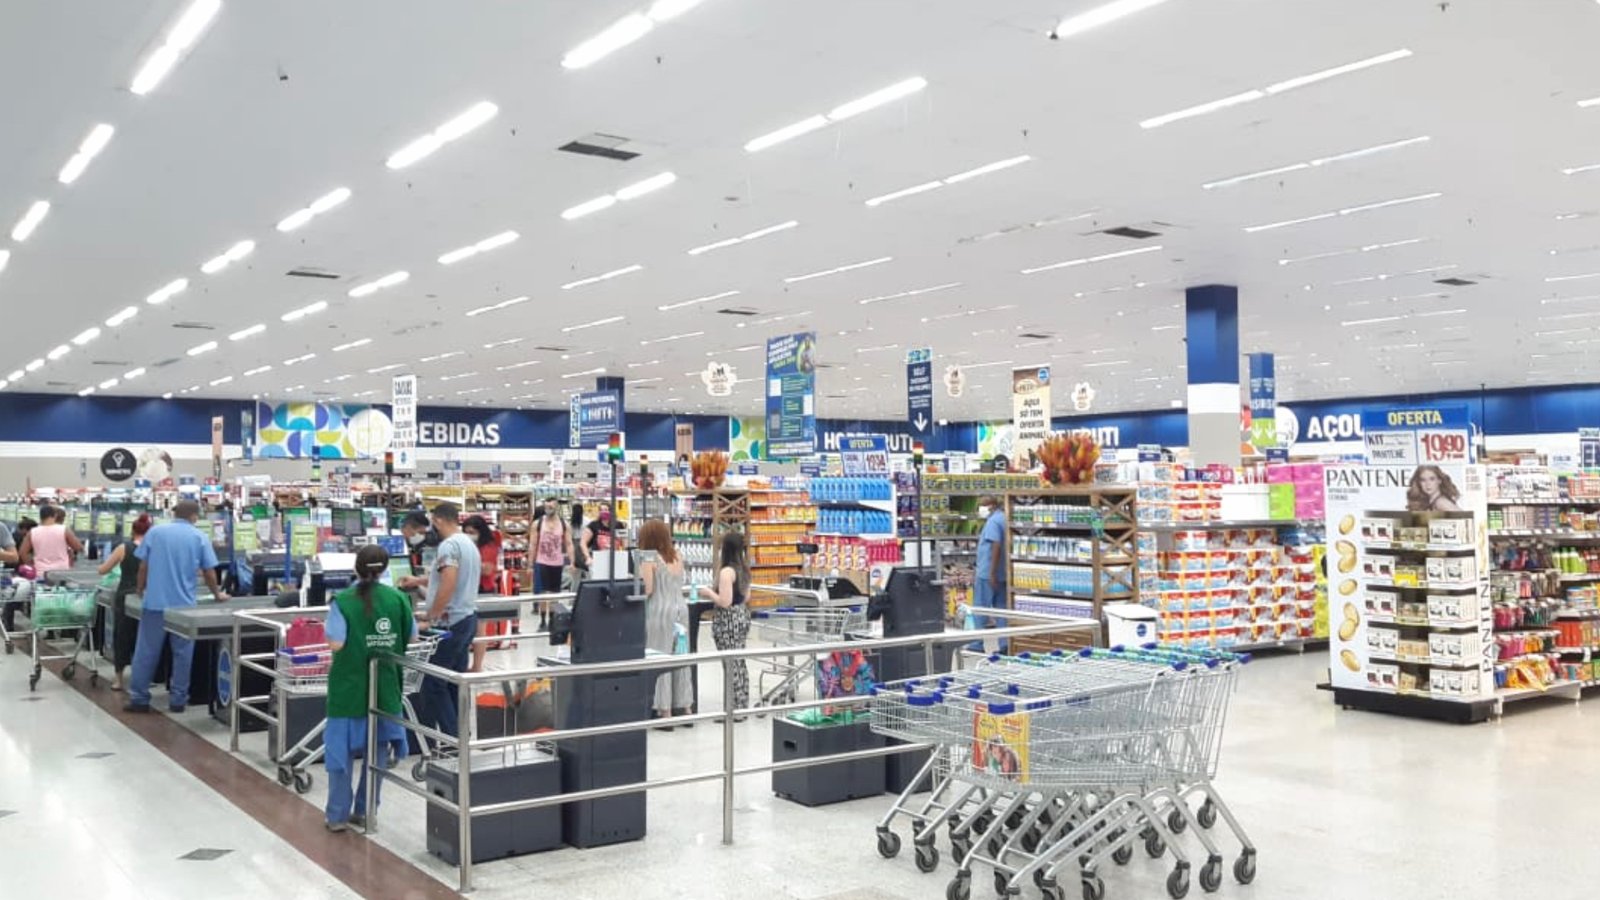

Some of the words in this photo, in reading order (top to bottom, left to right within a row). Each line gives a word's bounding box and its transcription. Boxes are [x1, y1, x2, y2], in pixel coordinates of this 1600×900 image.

[1019, 420, 1044, 429] OFERTA
[1387, 410, 1443, 426] OFERTA
[1367, 434, 1384, 446] KIT
[1326, 469, 1412, 487] PANTENE
